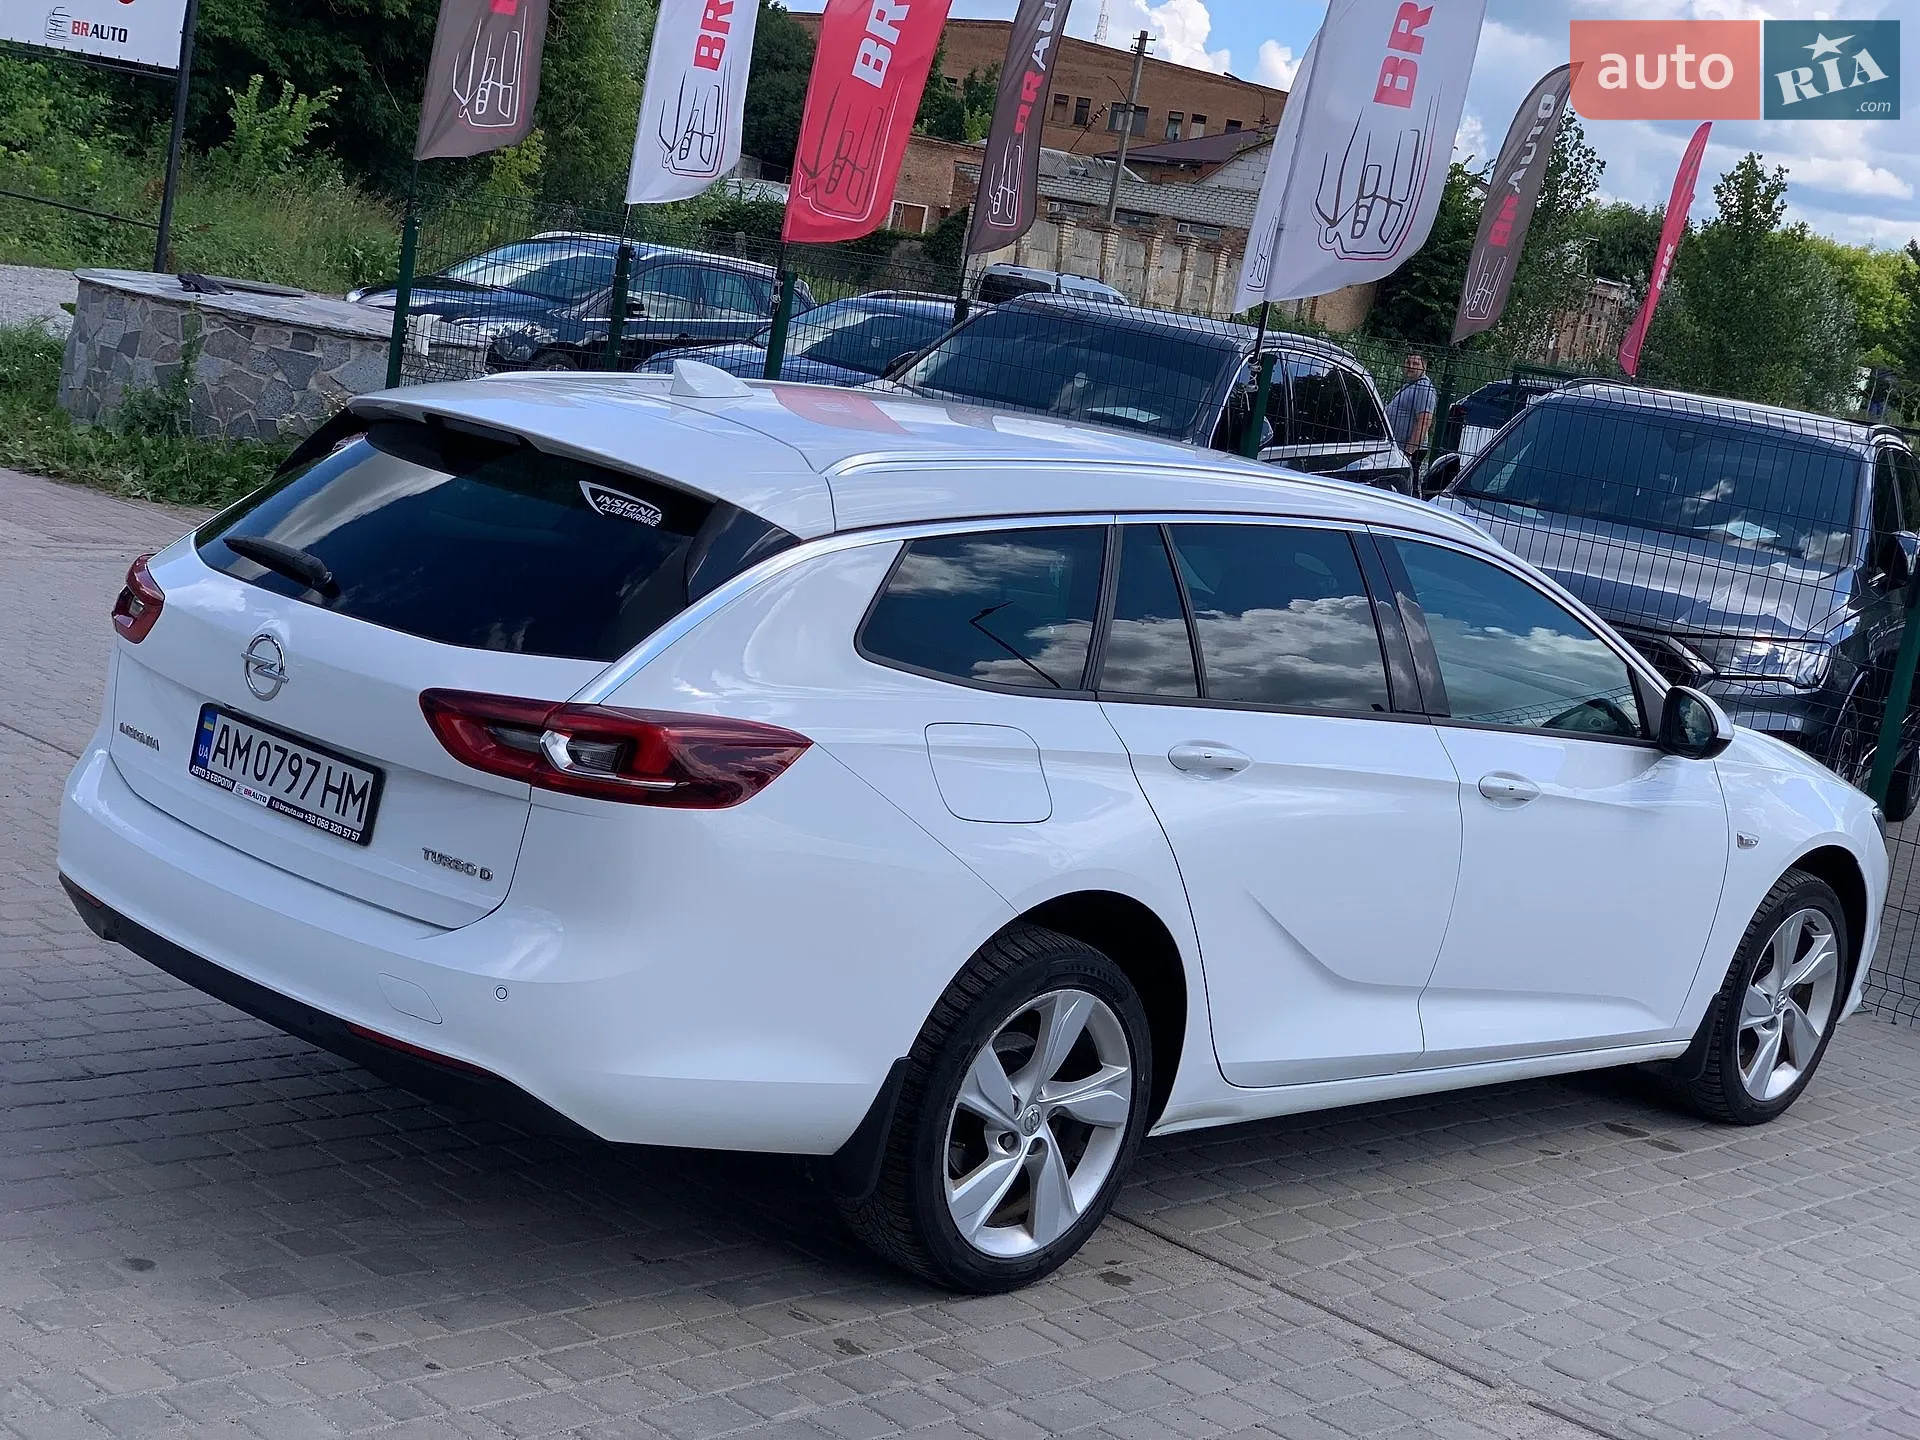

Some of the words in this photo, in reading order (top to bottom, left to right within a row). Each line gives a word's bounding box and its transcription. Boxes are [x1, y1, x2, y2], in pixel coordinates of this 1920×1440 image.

[1373, 1, 1434, 108] BR
[596, 495, 662, 521] INSIGNIA
[599, 503, 622, 515] CLUB
[622, 510, 659, 527] UKRAINE
[198, 744, 209, 760] UA
[211, 724, 253, 776] AM
[253, 740, 321, 800] 0797
[319, 765, 370, 823] HM
[329, 822, 342, 835] 320
[342, 828, 352, 838] 57
[351, 831, 361, 842] 57
[421, 846, 477, 877] TURBO
[479, 866, 494, 881] D
